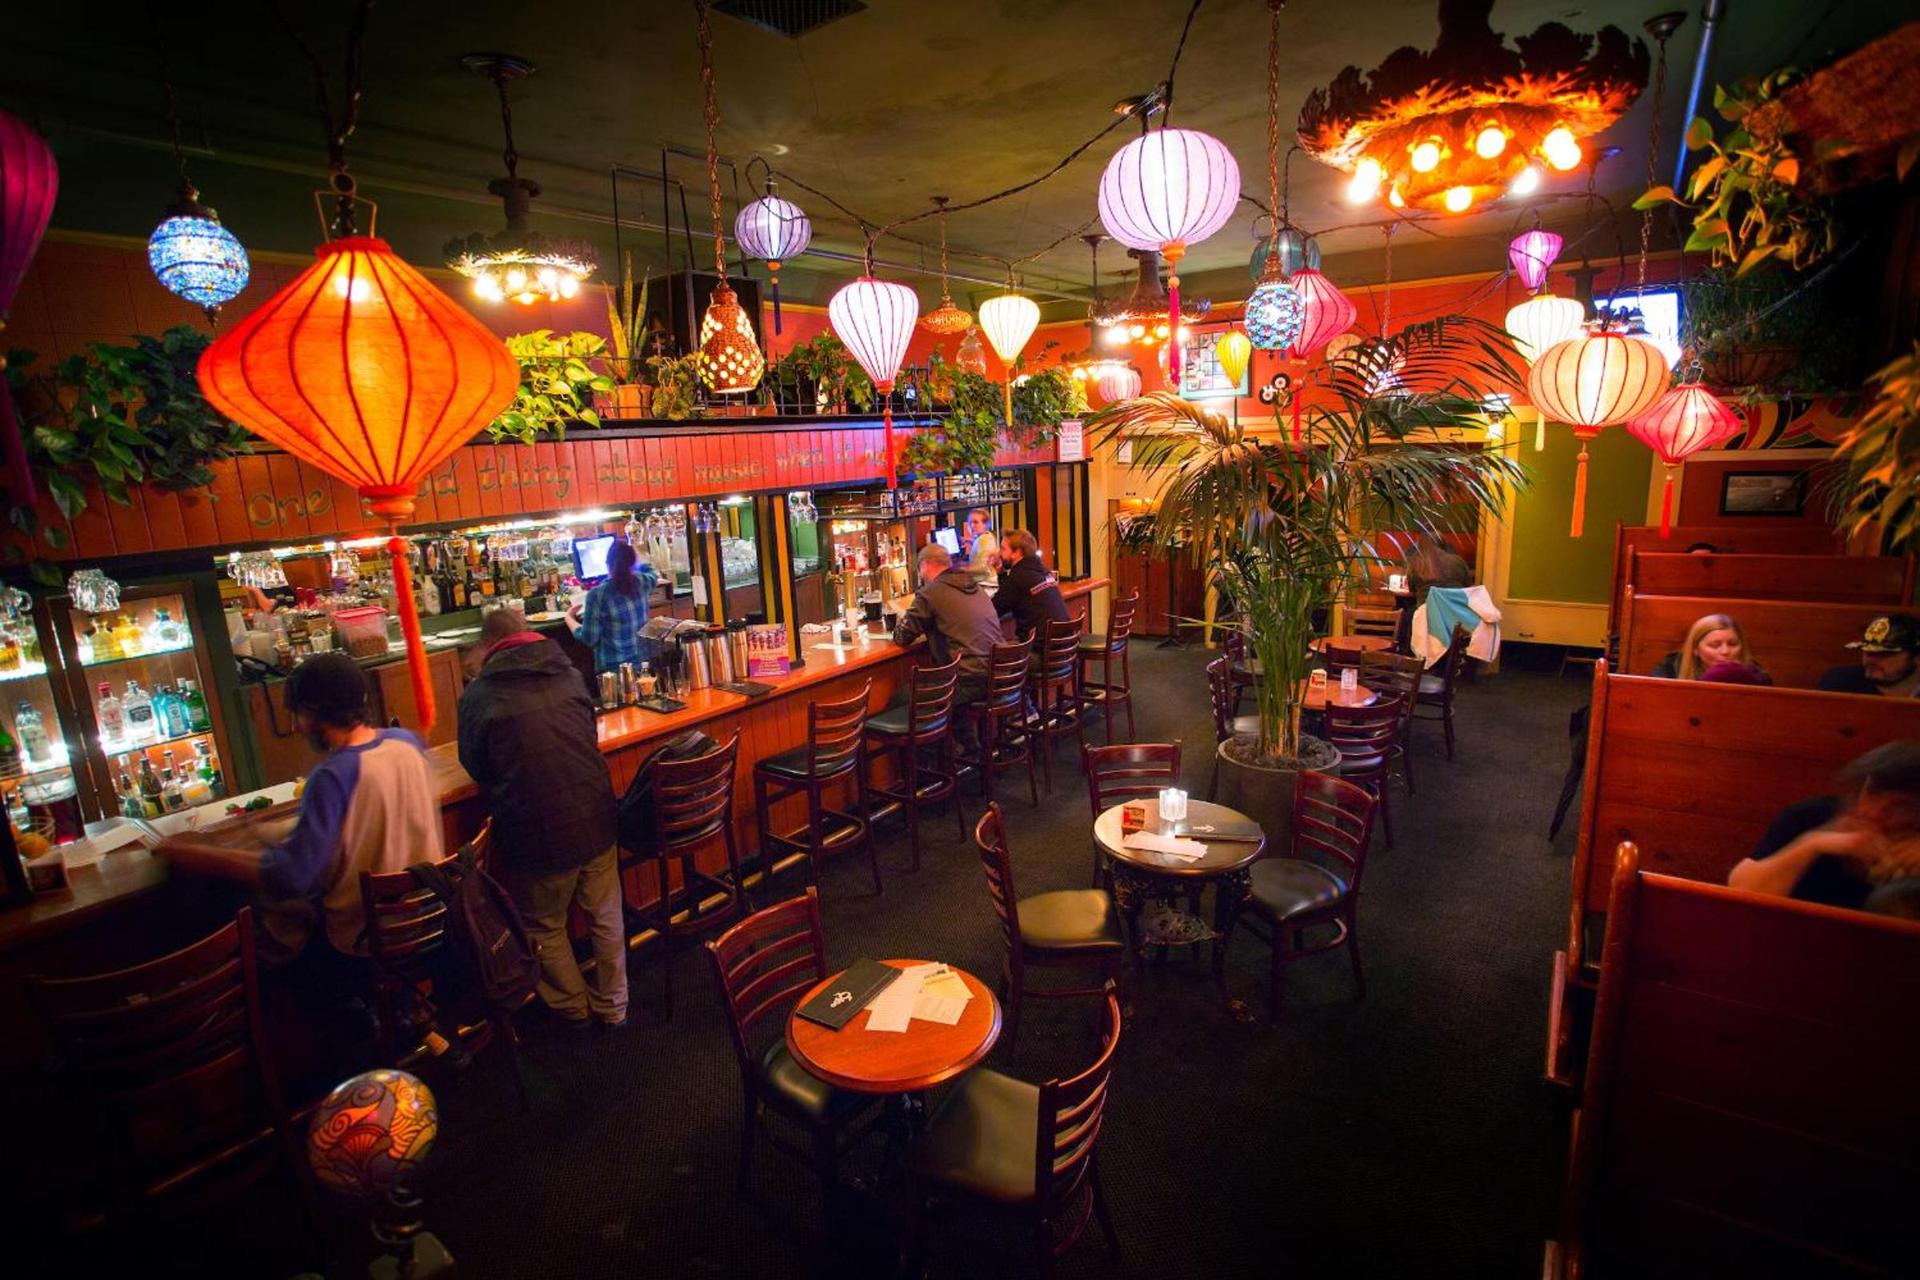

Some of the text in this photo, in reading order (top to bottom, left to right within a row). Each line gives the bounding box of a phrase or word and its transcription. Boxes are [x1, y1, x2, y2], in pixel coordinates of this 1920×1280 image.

[249, 489, 332, 528] One
[479, 449, 572, 498] thing
[596, 453, 677, 485] about
